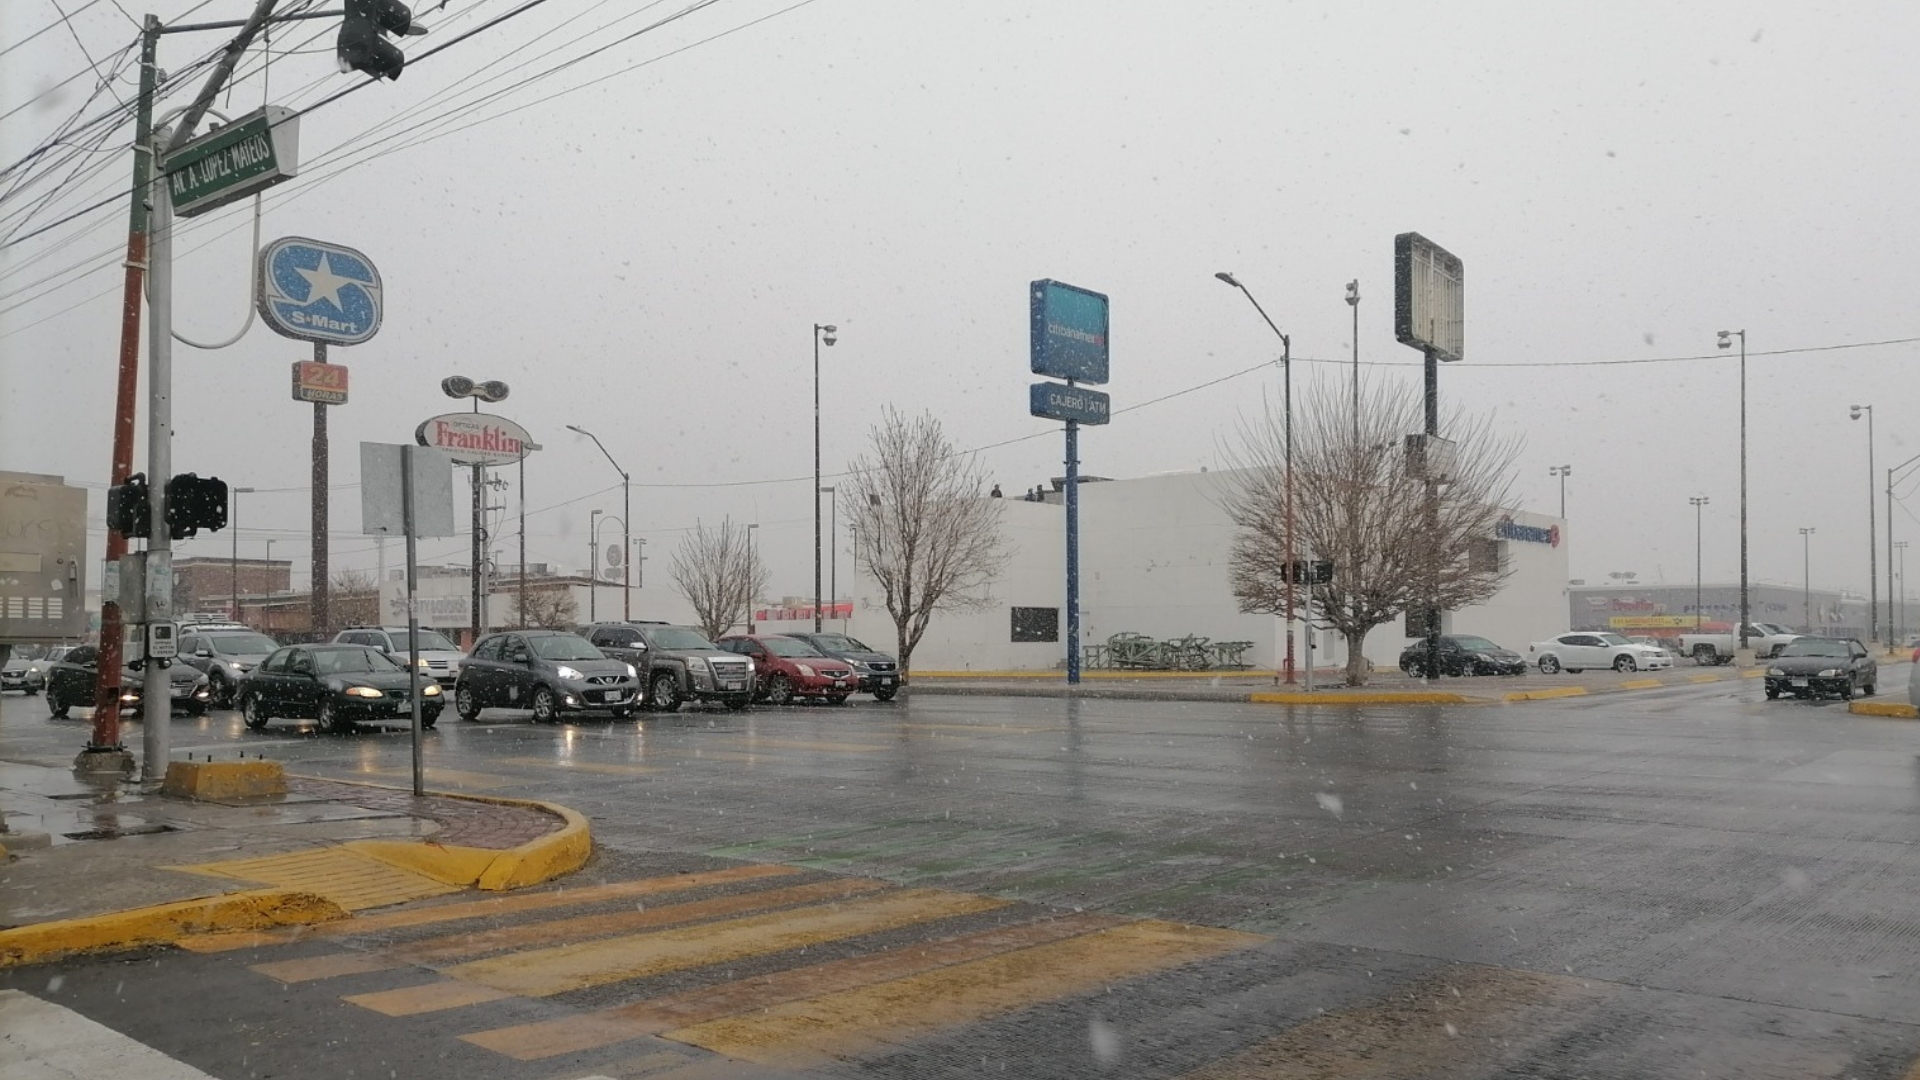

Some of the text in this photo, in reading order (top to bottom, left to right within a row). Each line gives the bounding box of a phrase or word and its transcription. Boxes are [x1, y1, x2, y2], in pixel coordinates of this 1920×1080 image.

[231, 132, 270, 171] MATEOS
[308, 366, 339, 386] 24
[308, 389, 344, 401] HORAS
[1050, 393, 1107, 415] CAJERO ATM
[434, 420, 521, 454] Franklin
